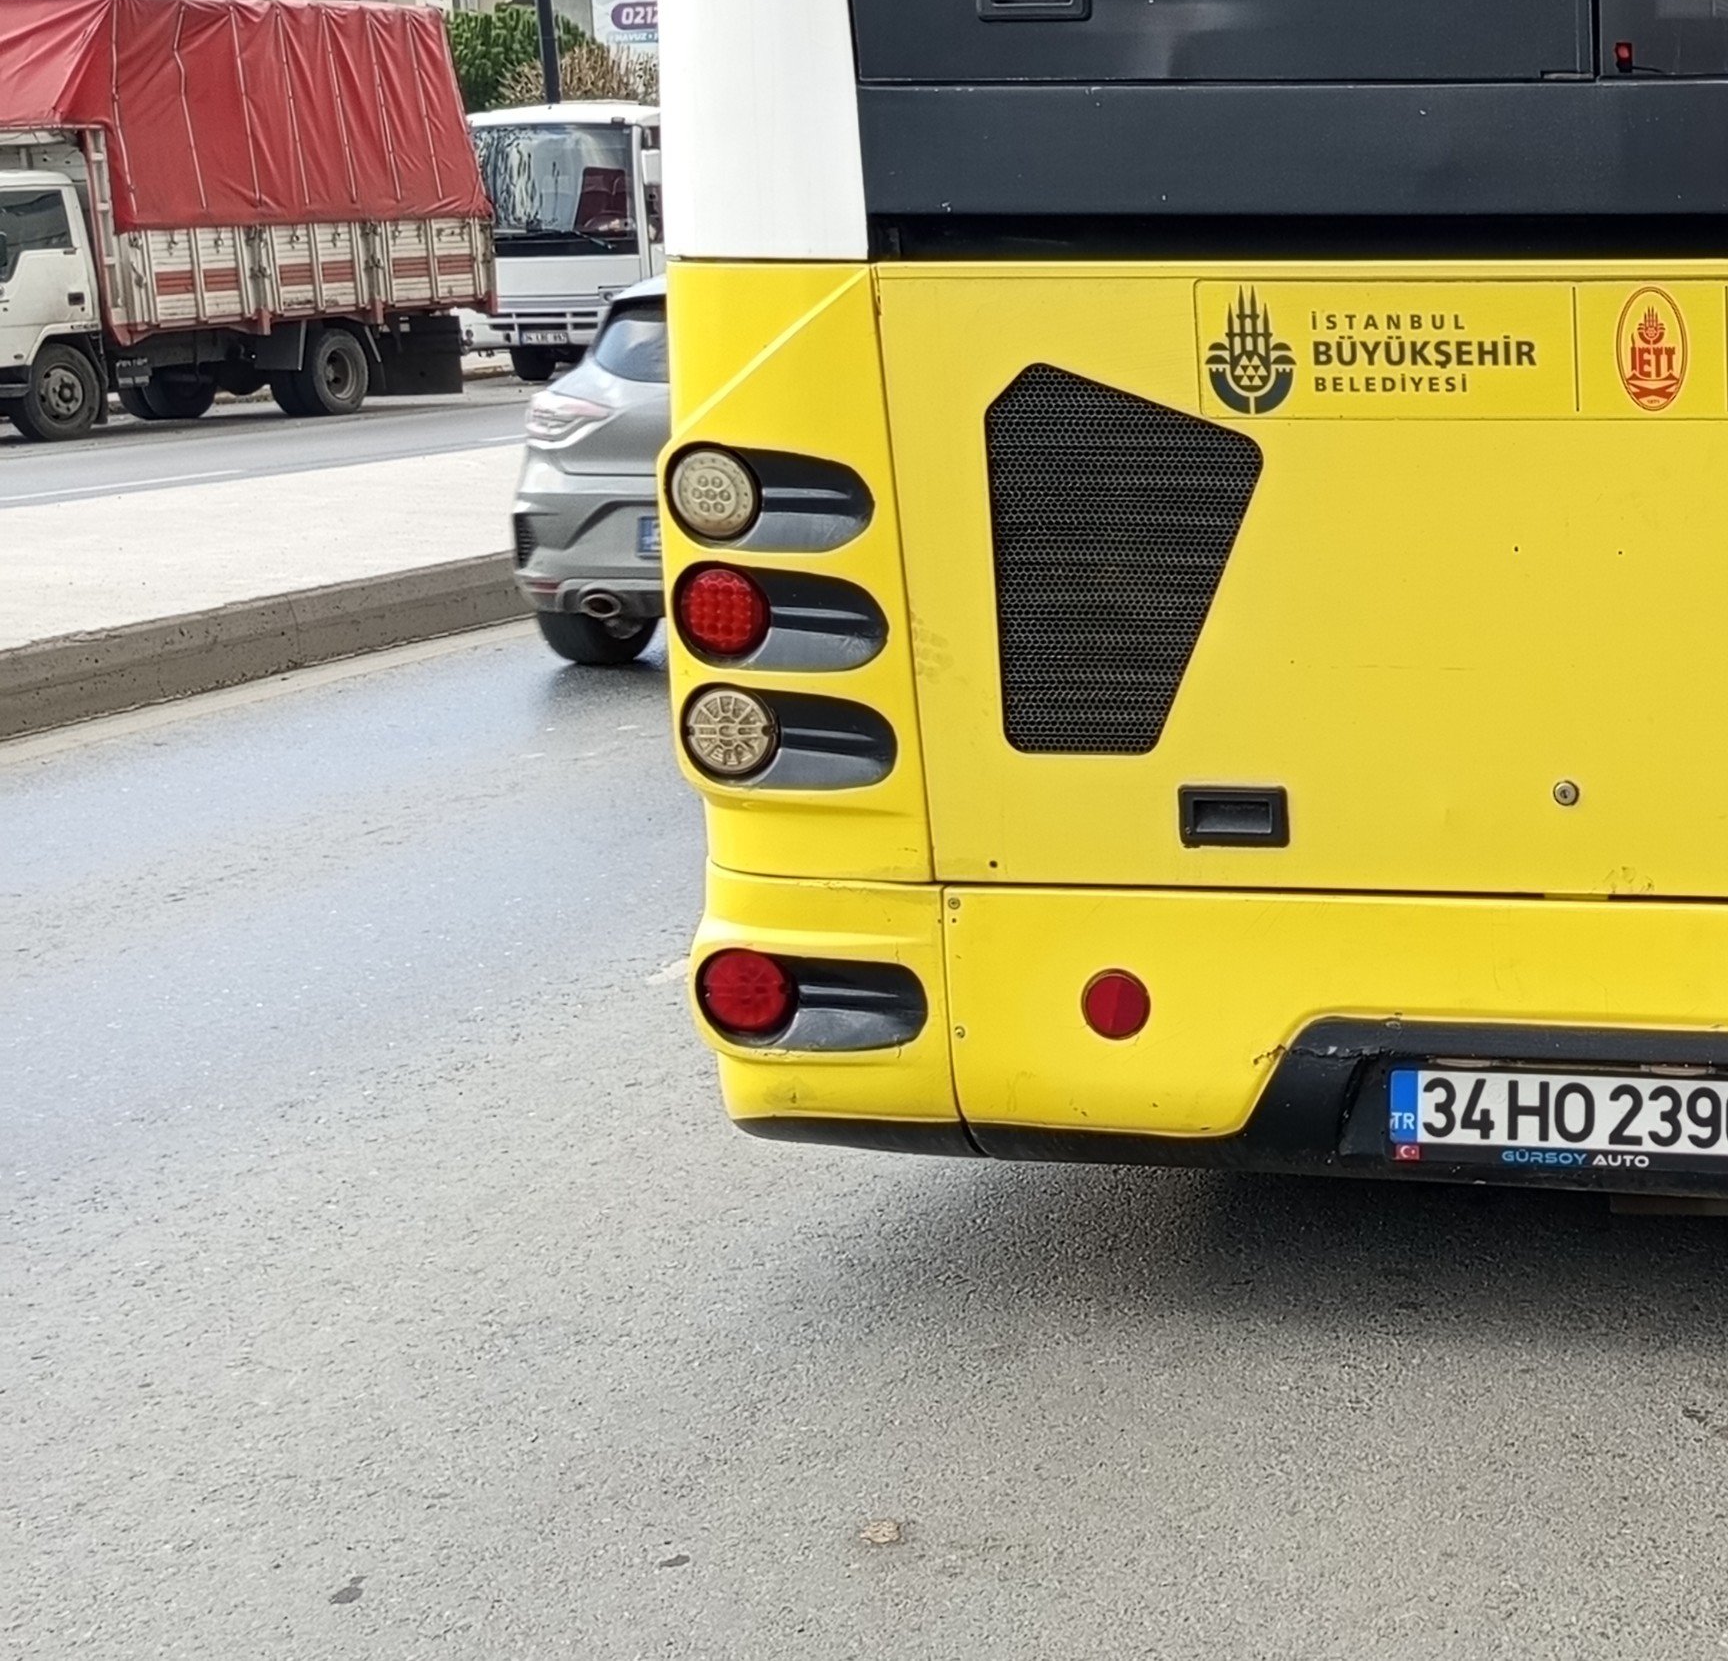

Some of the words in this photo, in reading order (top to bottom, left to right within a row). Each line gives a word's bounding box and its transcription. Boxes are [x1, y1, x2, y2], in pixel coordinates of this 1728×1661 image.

[1311, 311, 1465, 330] İSTANBUL
[1313, 335, 1537, 370] BÜYÜKŞEHİR
[1314, 373, 1468, 393] BELEDİYESİ
[1423, 1077, 1495, 1139] 34
[1507, 1080, 1595, 1143] HO
[1391, 1112, 1415, 1130] TR
[1502, 1149, 1586, 1165] GÜRSOY
[1592, 1154, 1650, 1169] AUTO
